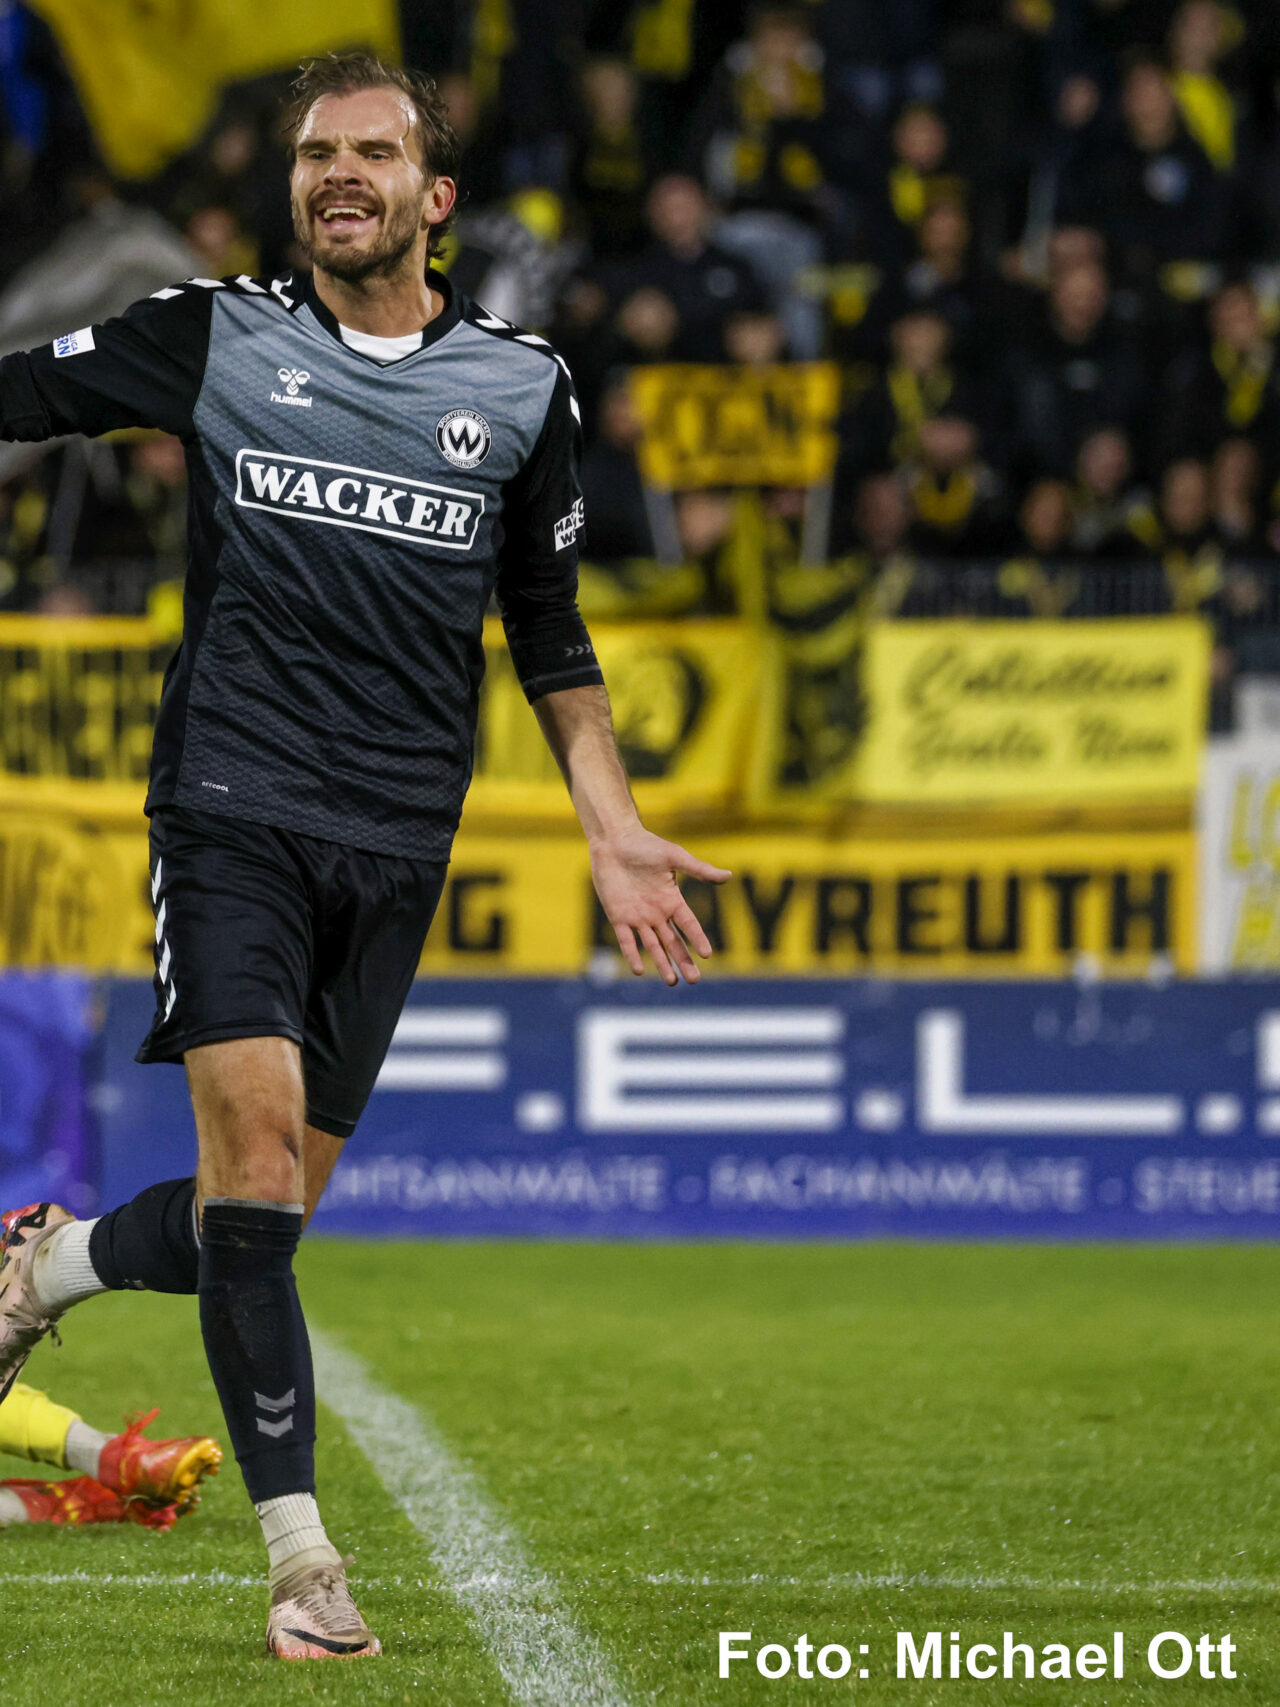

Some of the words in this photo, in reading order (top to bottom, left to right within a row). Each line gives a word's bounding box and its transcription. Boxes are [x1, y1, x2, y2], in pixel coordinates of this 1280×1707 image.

[270, 391, 313, 408] hummel
[448, 421, 482, 455] W
[245, 461, 472, 537] WACKER
[1134, 1157, 1280, 1213] STEUE
